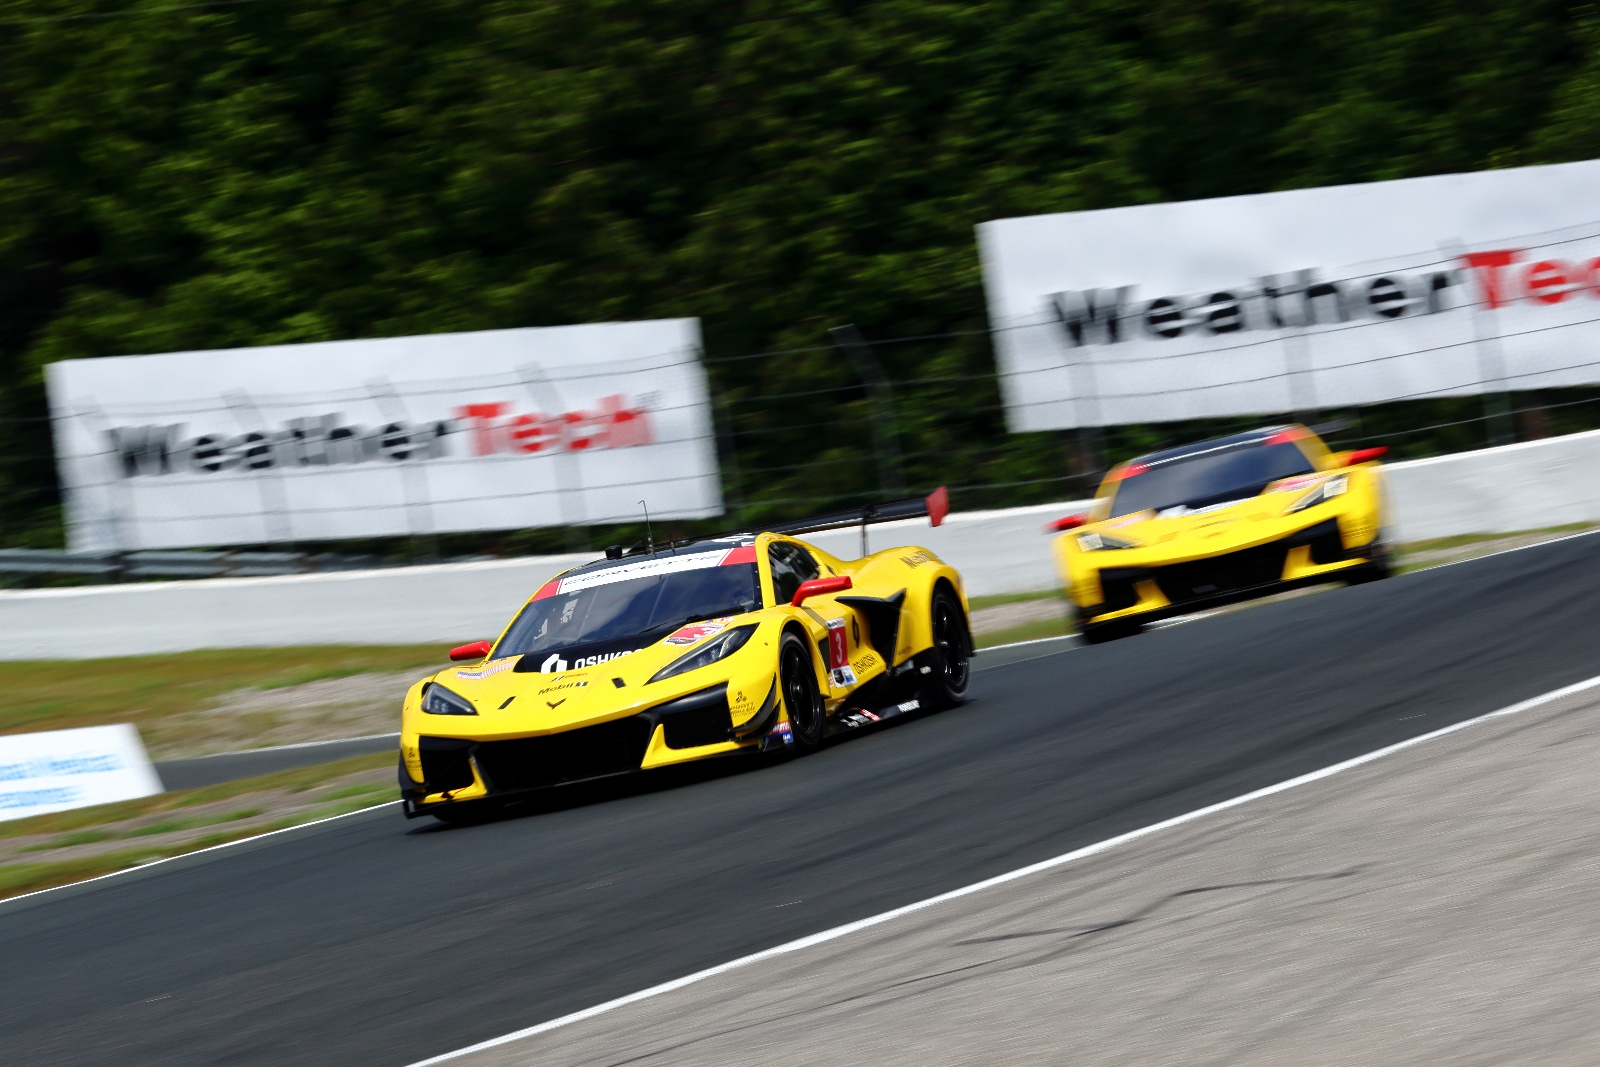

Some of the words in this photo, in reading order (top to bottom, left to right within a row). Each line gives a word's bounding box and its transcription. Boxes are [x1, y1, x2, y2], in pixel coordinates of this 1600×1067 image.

[1045, 248, 1600, 346] WeatherTe
[107, 394, 657, 478] WeatherTech
[835, 632, 843, 664] 3
[538, 682, 574, 695] Mobil
